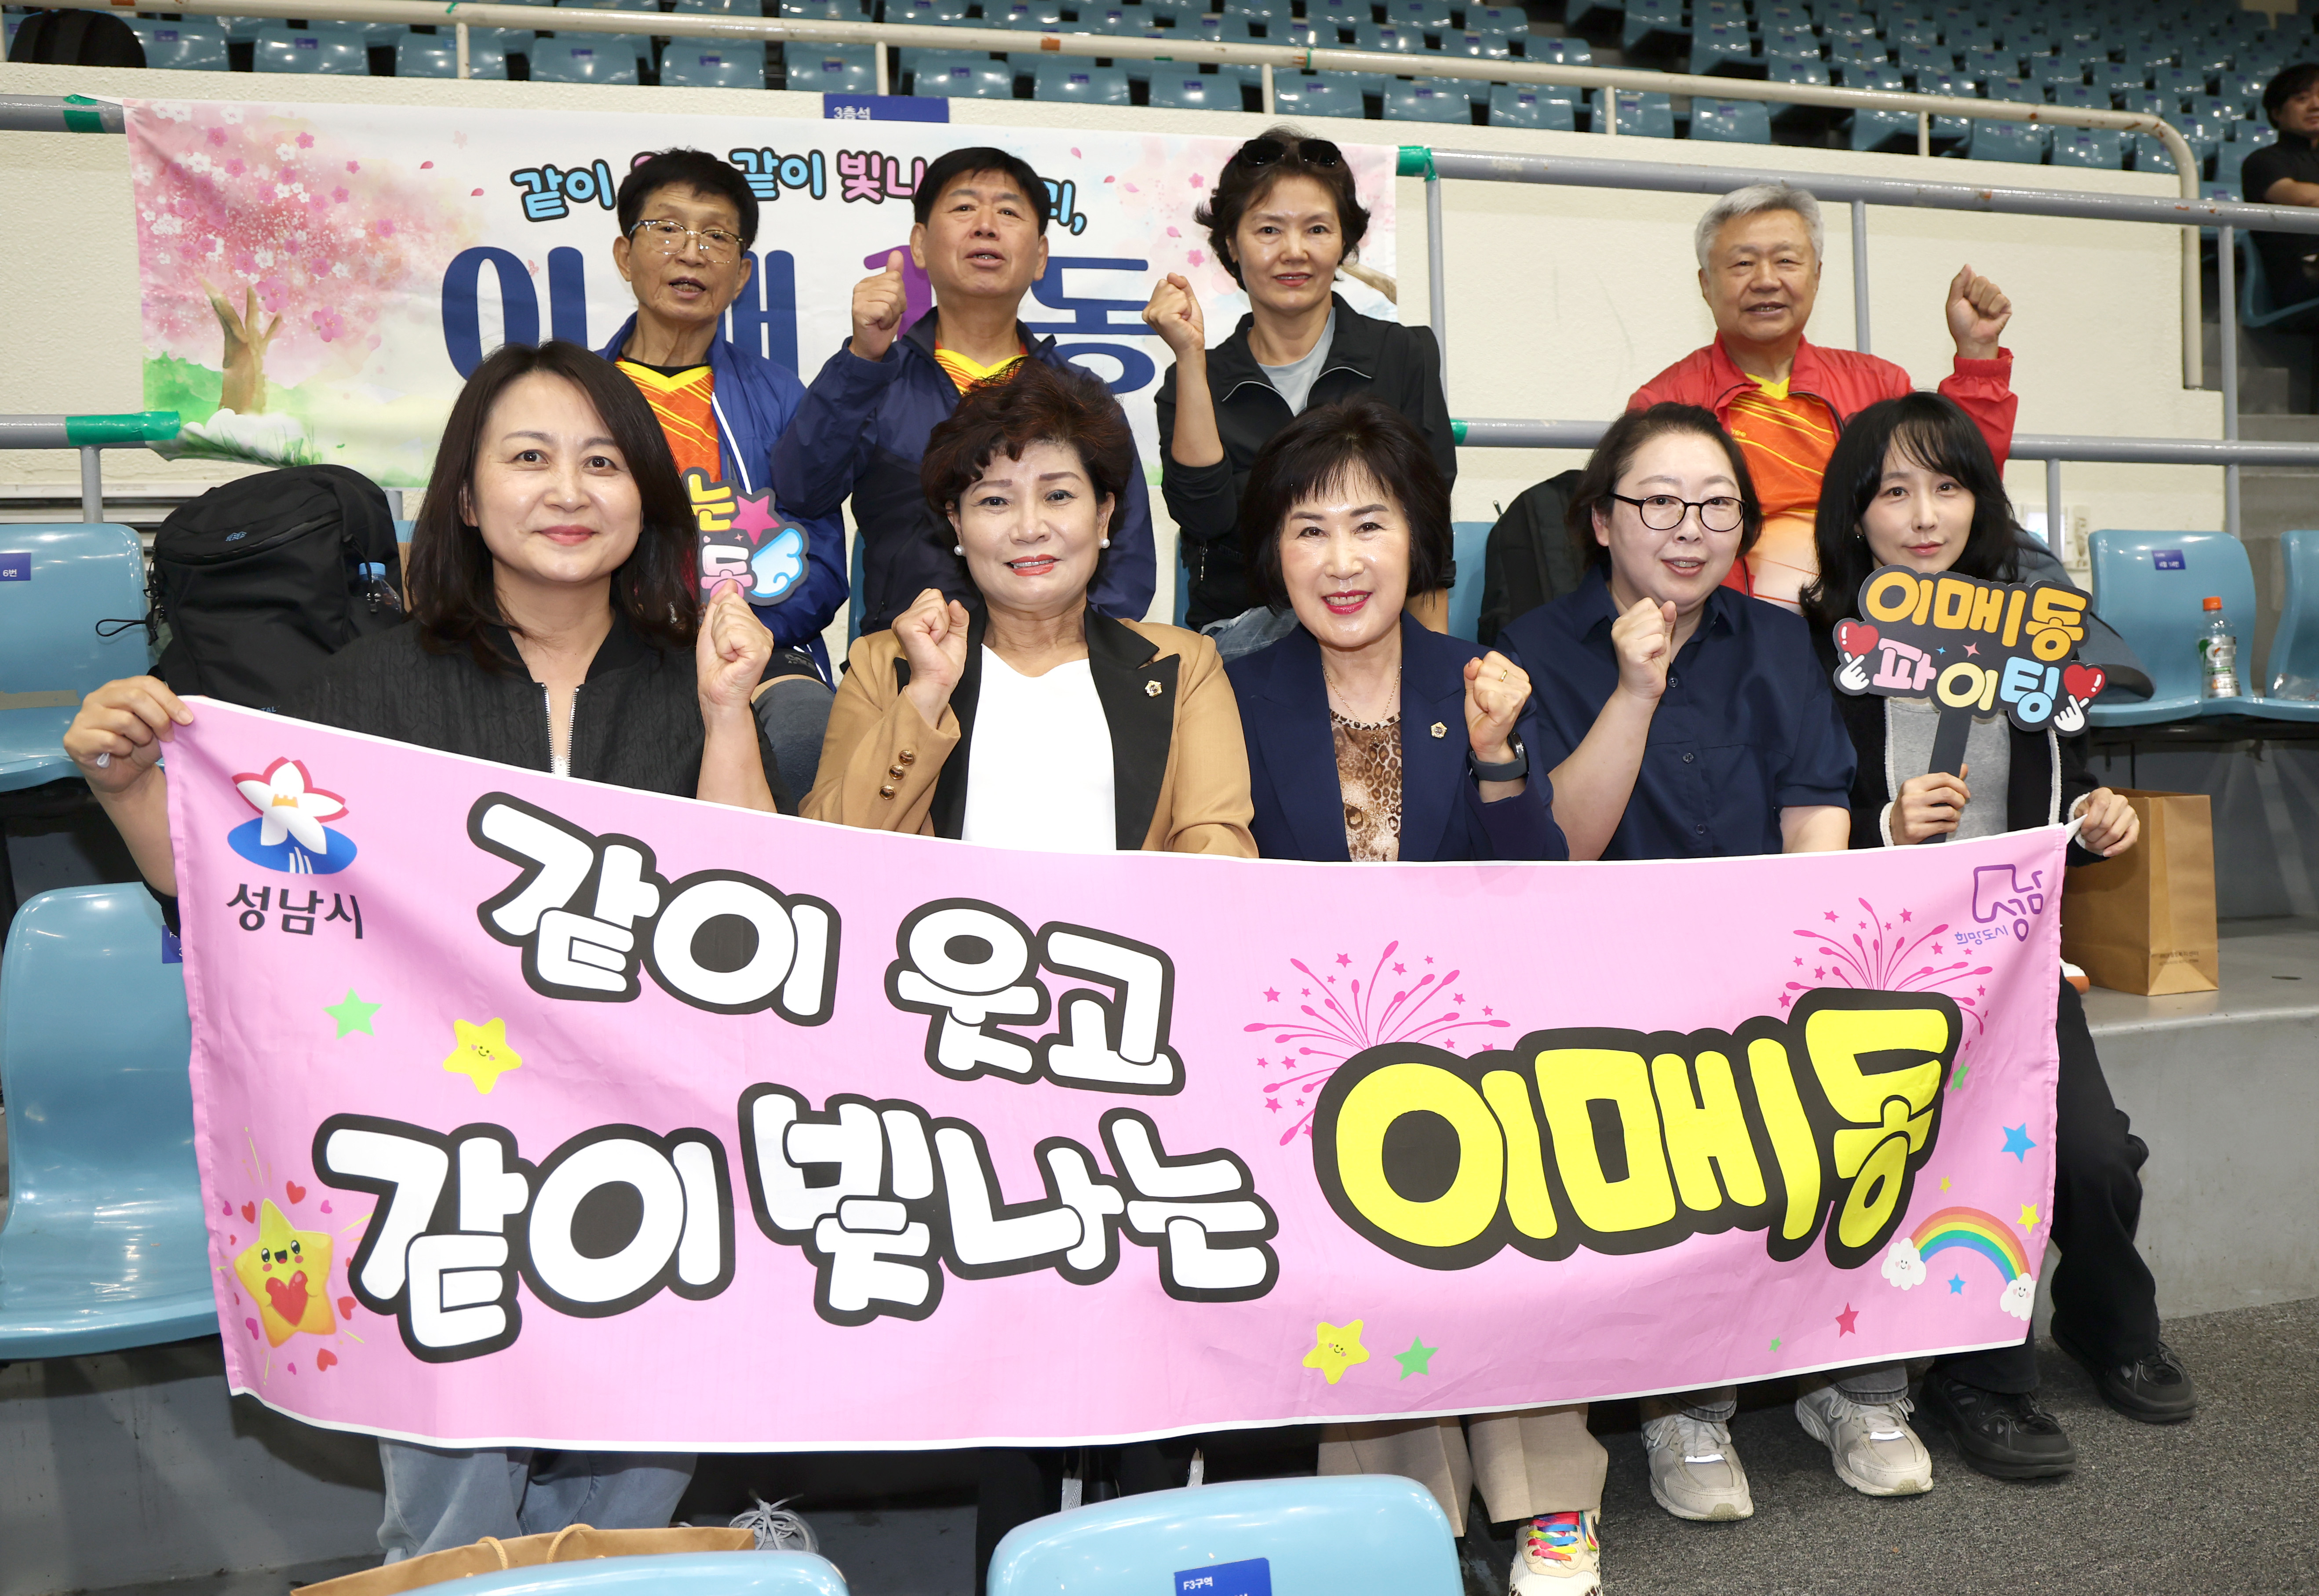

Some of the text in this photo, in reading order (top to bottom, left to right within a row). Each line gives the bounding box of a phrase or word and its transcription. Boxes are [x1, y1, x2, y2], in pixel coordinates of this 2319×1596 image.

[834, 106, 871, 120] 3층석
[510, 159, 616, 222] 같이
[729, 147, 826, 201] 같이
[837, 149, 928, 204] 빛나
[1866, 571, 2087, 661] 이매동
[1873, 638, 2060, 723] 파이팅
[226, 883, 363, 939] 성남시
[467, 791, 1186, 1096] 같이 웃고
[1954, 925, 2009, 945] 희망도시
[312, 987, 1962, 1363] 같이 빛나는 이매동
[1183, 1576, 1214, 1590] F3구역
